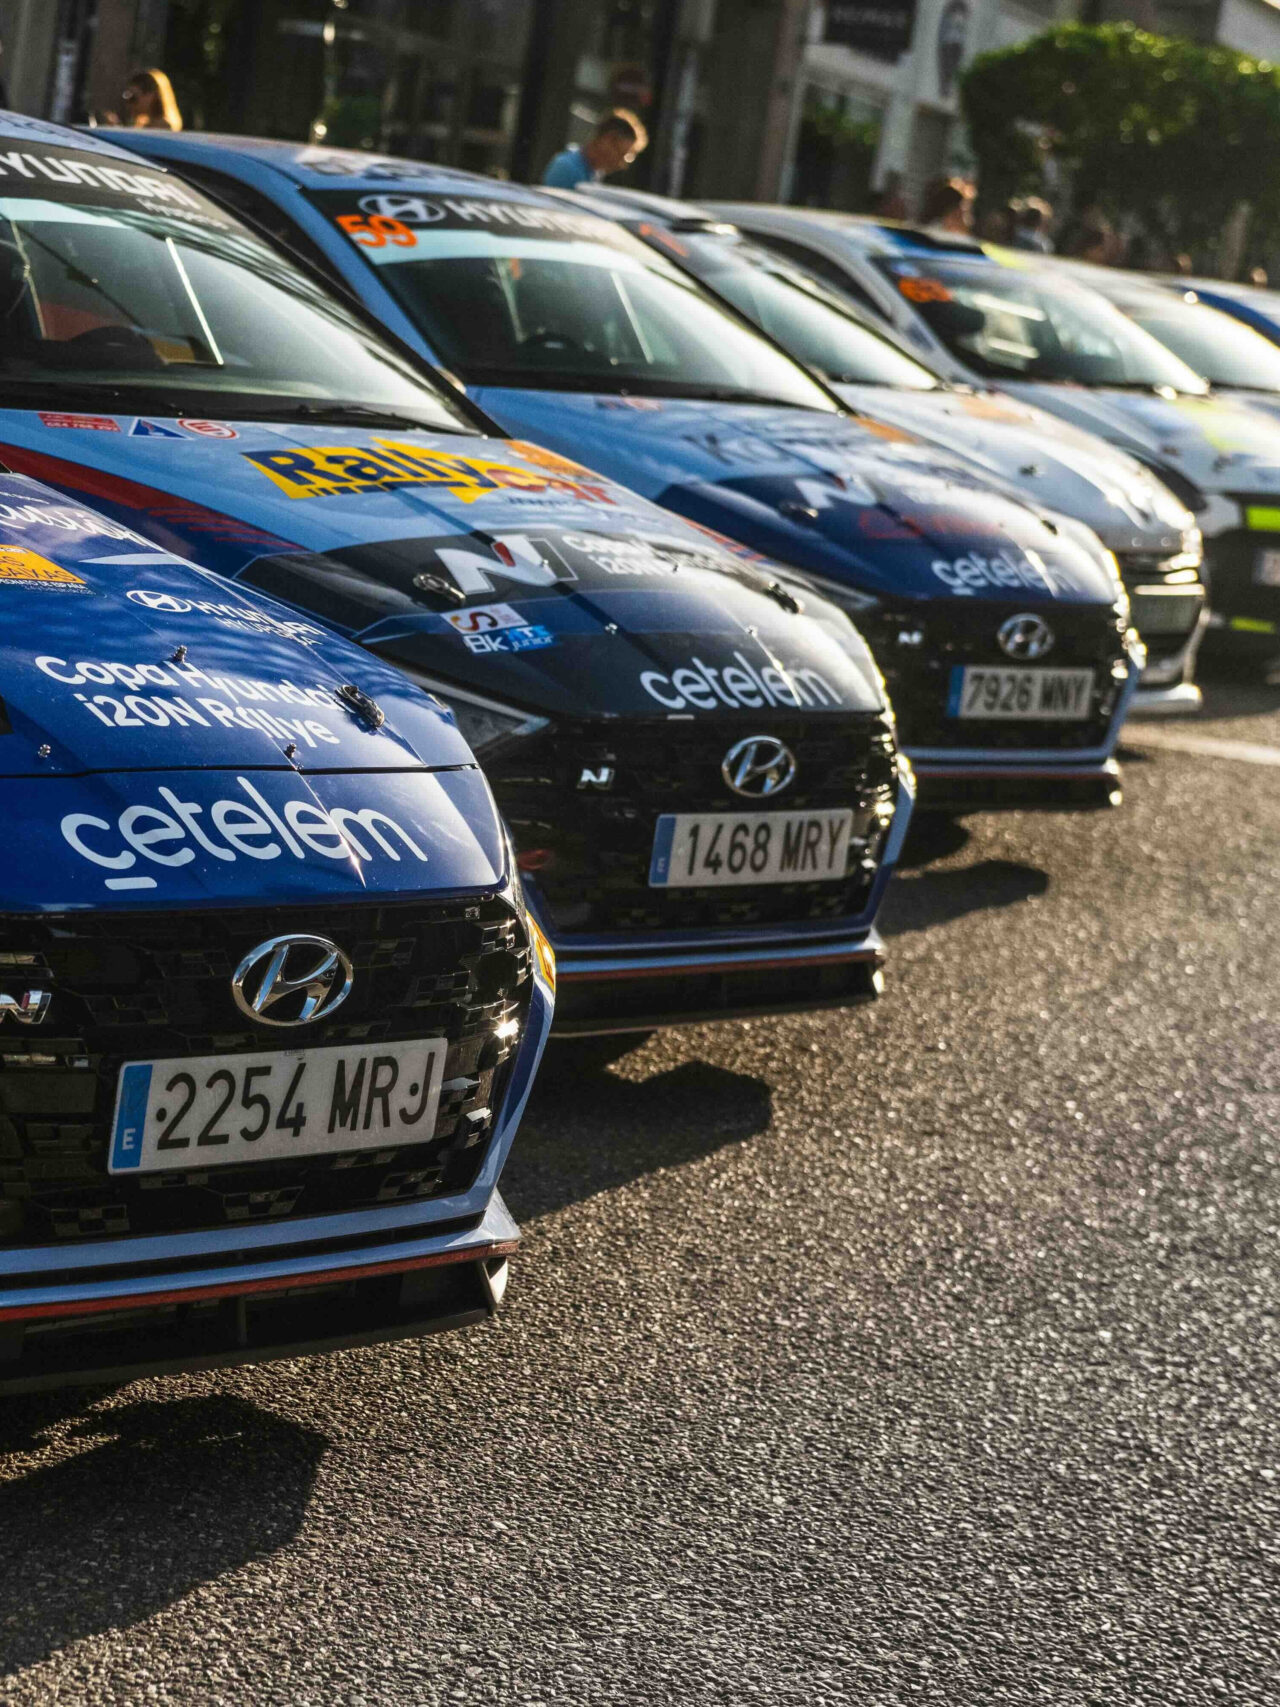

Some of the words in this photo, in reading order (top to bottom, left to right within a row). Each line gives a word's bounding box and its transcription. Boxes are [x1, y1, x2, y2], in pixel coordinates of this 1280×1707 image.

[336, 214, 418, 248] 59
[258, 446, 500, 490] Rally
[35, 655, 171, 692] Copa
[639, 651, 844, 710] cetelem
[72, 692, 212, 728] i20N
[195, 697, 342, 749] Rallye
[60, 776, 429, 878] cetelem
[686, 822, 771, 877] 1468
[778, 818, 845, 873] MRY
[156, 1062, 308, 1151] 2254
[327, 1051, 437, 1135] MRJ
